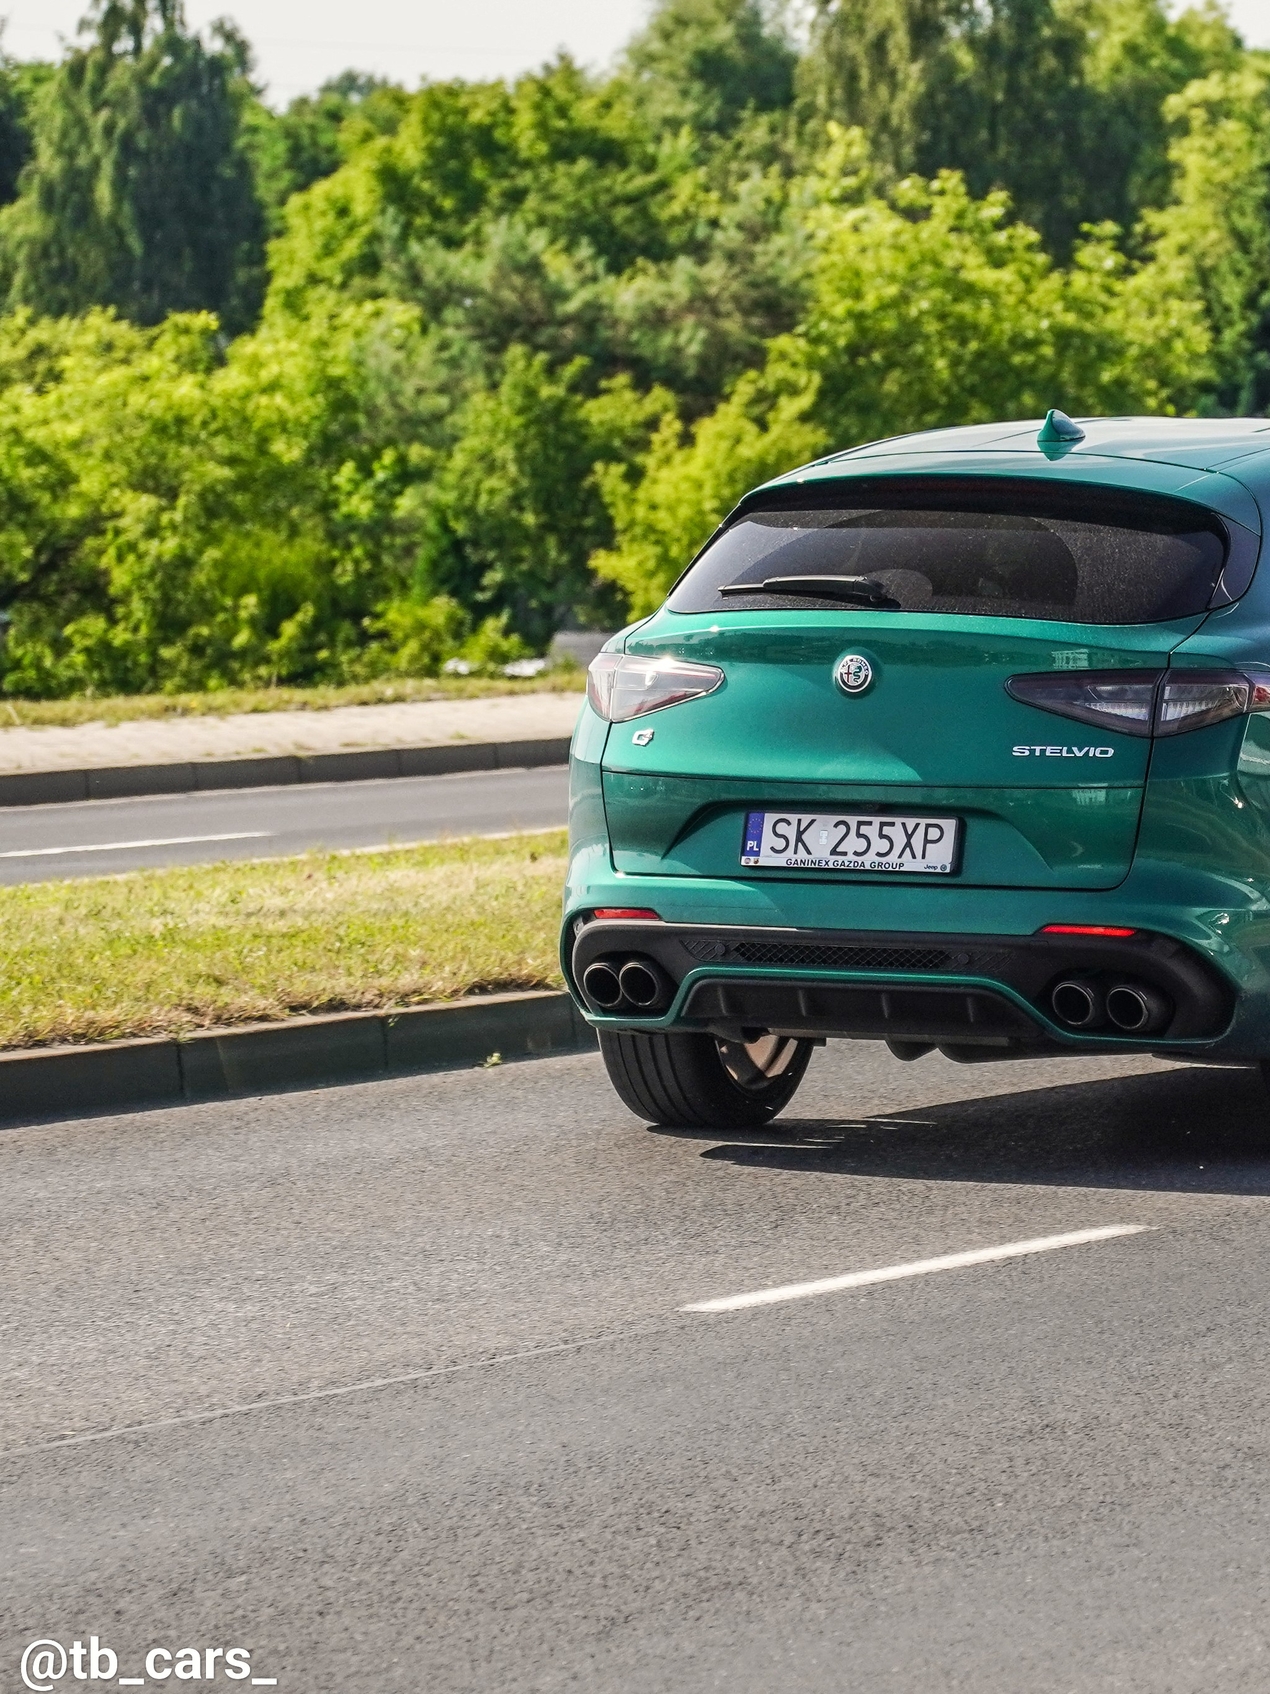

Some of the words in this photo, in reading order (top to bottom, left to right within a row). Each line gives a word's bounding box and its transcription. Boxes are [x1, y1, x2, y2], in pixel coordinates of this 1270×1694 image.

[1011, 745, 1115, 758] STELVIO
[769, 817, 817, 856] SK
[829, 820, 945, 860] 255XP
[746, 840, 759, 851] PL
[785, 858, 830, 868] GANINEX
[832, 859, 866, 869] GAZDA
[869, 861, 905, 870] GROUP
